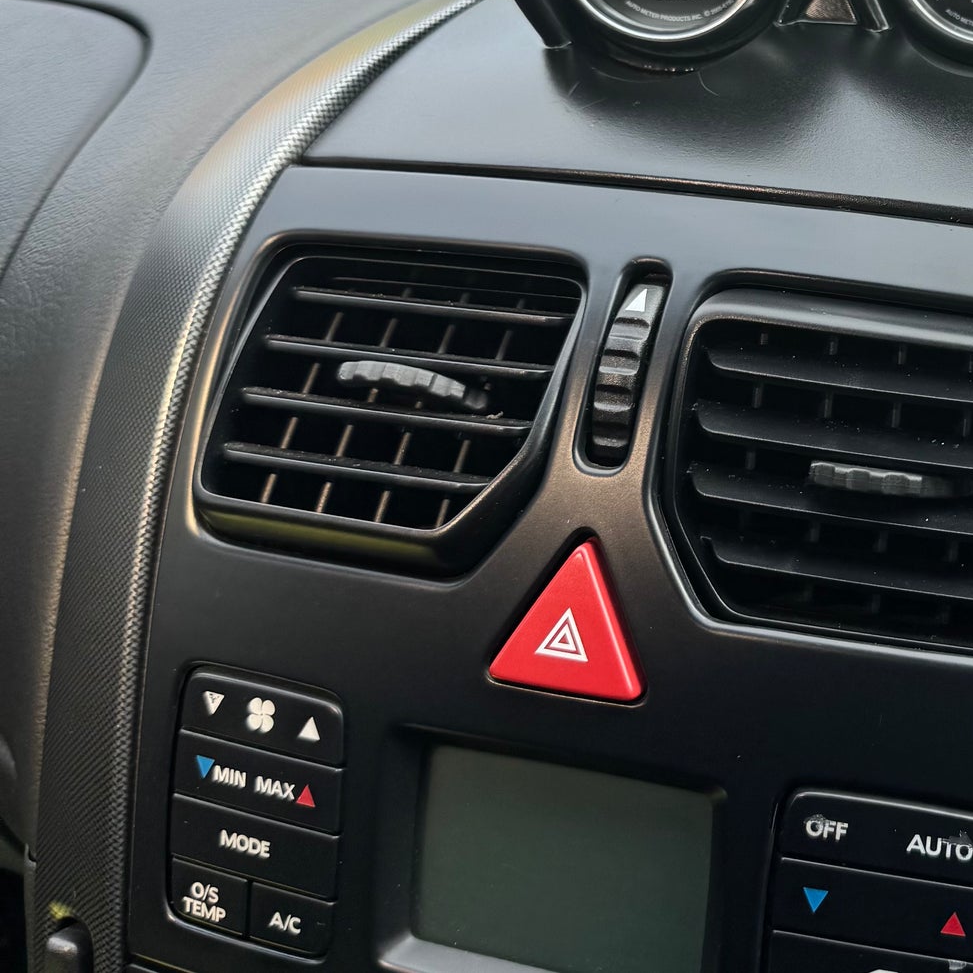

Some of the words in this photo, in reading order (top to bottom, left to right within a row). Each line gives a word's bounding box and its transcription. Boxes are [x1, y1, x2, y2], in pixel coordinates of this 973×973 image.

[625, 0, 641, 11] AUTO
[640, 8, 660, 19] METER
[660, 13, 692, 22] PRODUCTS
[945, 8, 961, 20] AUTO
[212, 765, 247, 788] MIN
[254, 776, 295, 801] MAX
[805, 816, 849, 842] OFF
[219, 829, 271, 859] MODE
[906, 833, 973, 862] AUTO
[191, 881, 220, 904] O/S
[182, 895, 227, 923] TEMP
[269, 911, 302, 936] A/C
